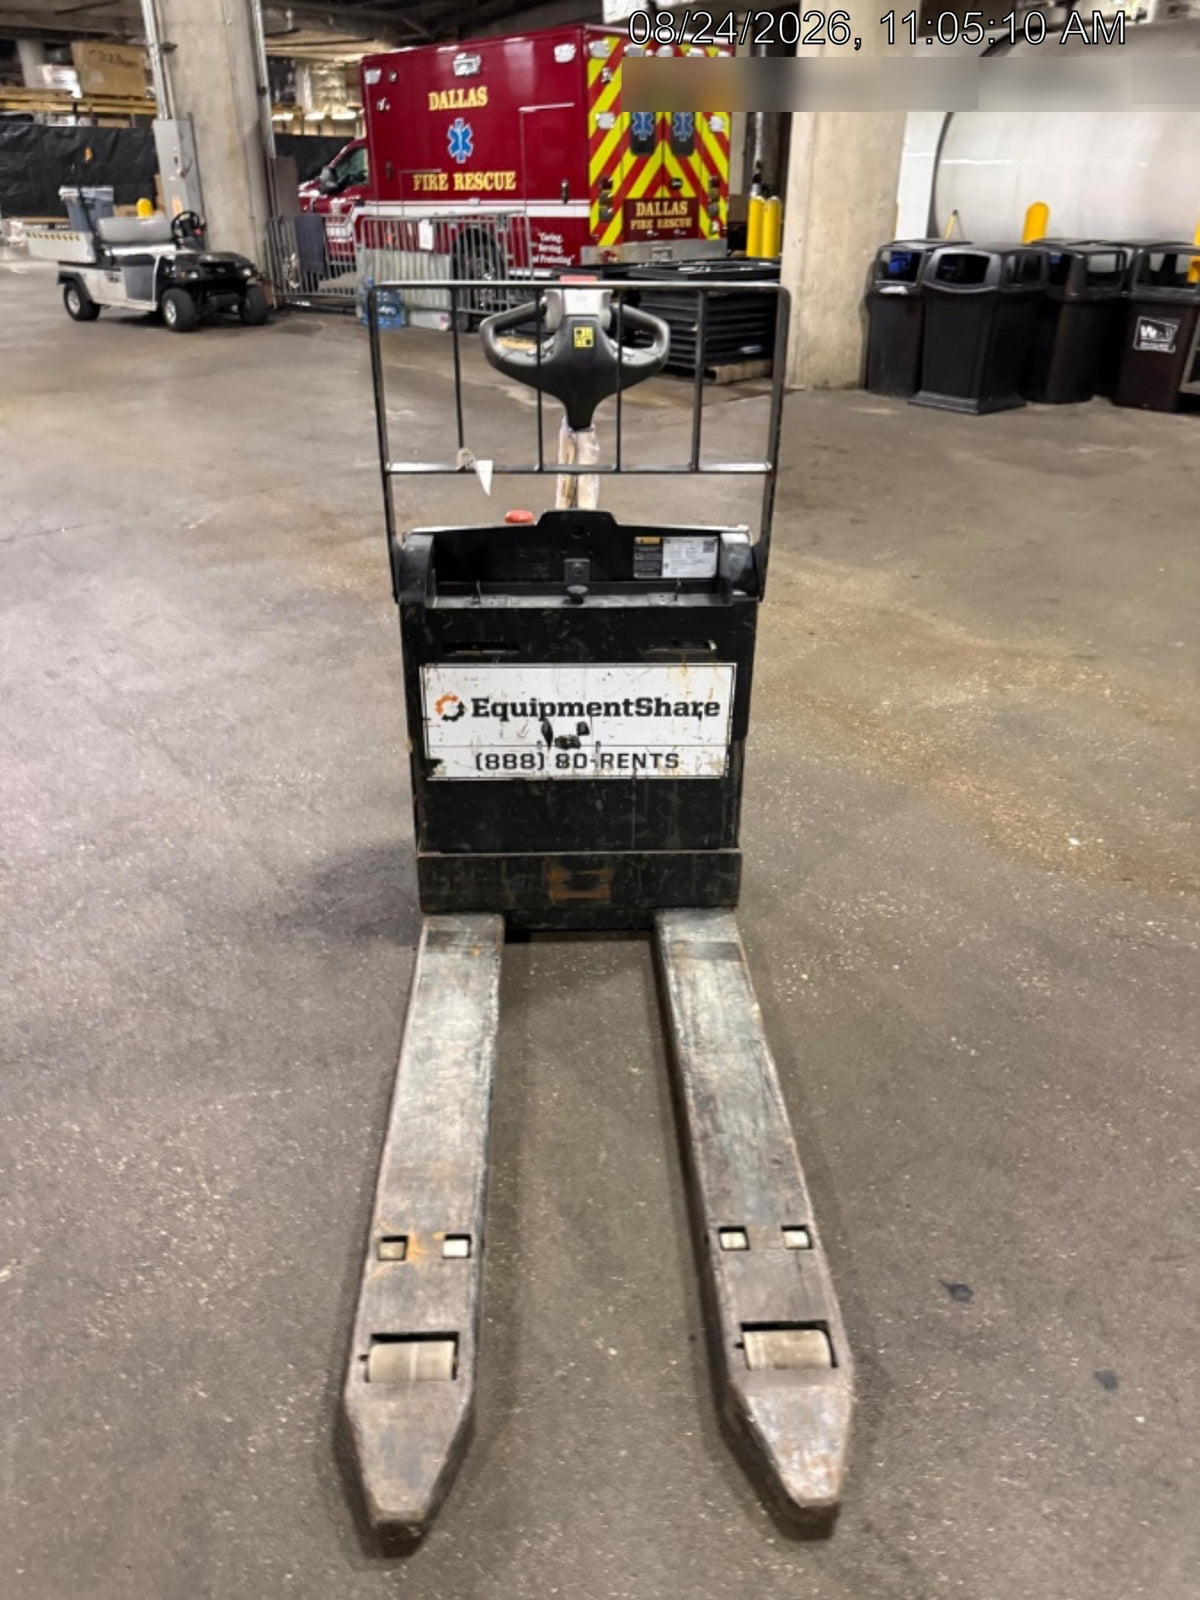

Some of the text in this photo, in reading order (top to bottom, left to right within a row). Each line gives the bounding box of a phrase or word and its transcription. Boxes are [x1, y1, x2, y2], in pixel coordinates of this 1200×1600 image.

[428, 86, 488, 111] DALLAS
[412, 170, 517, 191] FIRE RESCUE
[635, 200, 689, 217] DALLAS
[630, 217, 693, 230] FIRE RESCUE
[471, 697, 721, 721] EquipmentShare
[475, 753, 545, 770] (888)
